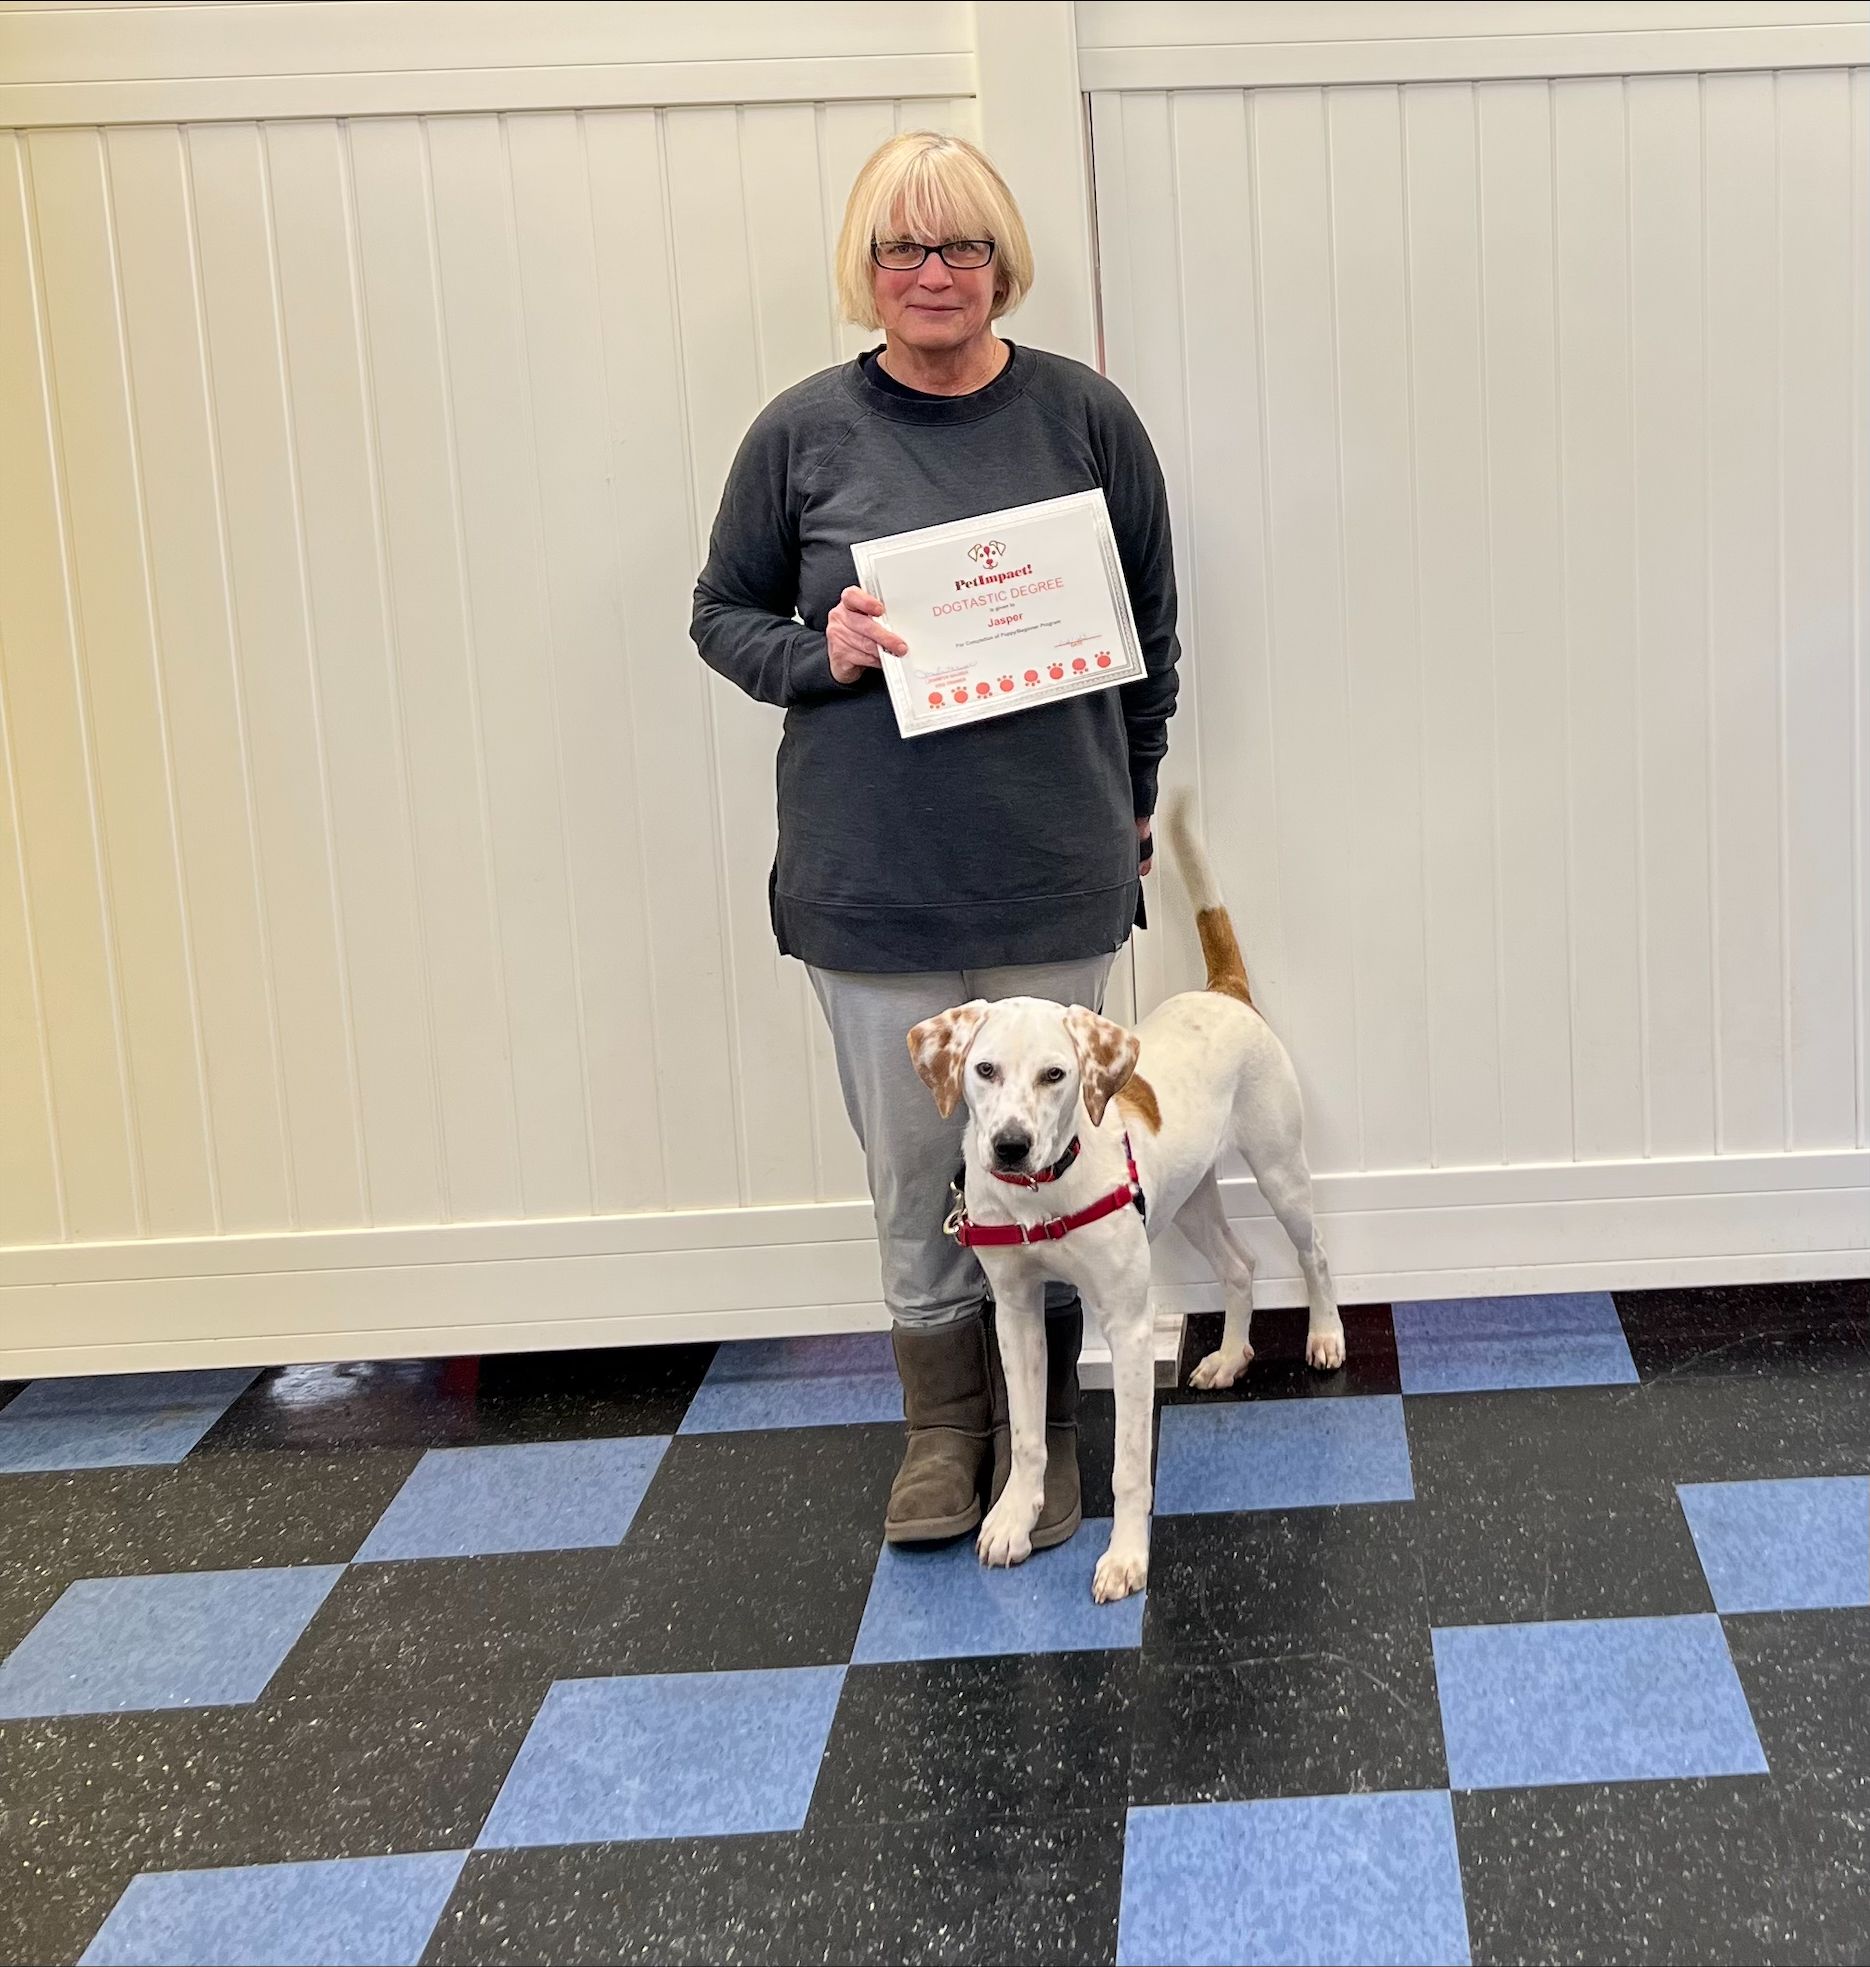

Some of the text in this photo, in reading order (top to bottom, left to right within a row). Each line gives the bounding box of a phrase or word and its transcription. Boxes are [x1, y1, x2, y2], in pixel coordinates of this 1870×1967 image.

[955, 564, 1032, 591] PetImpact!
[932, 577, 1064, 617] DOGTASTIC DEGREE
[987, 613, 1024, 628] Jasper
